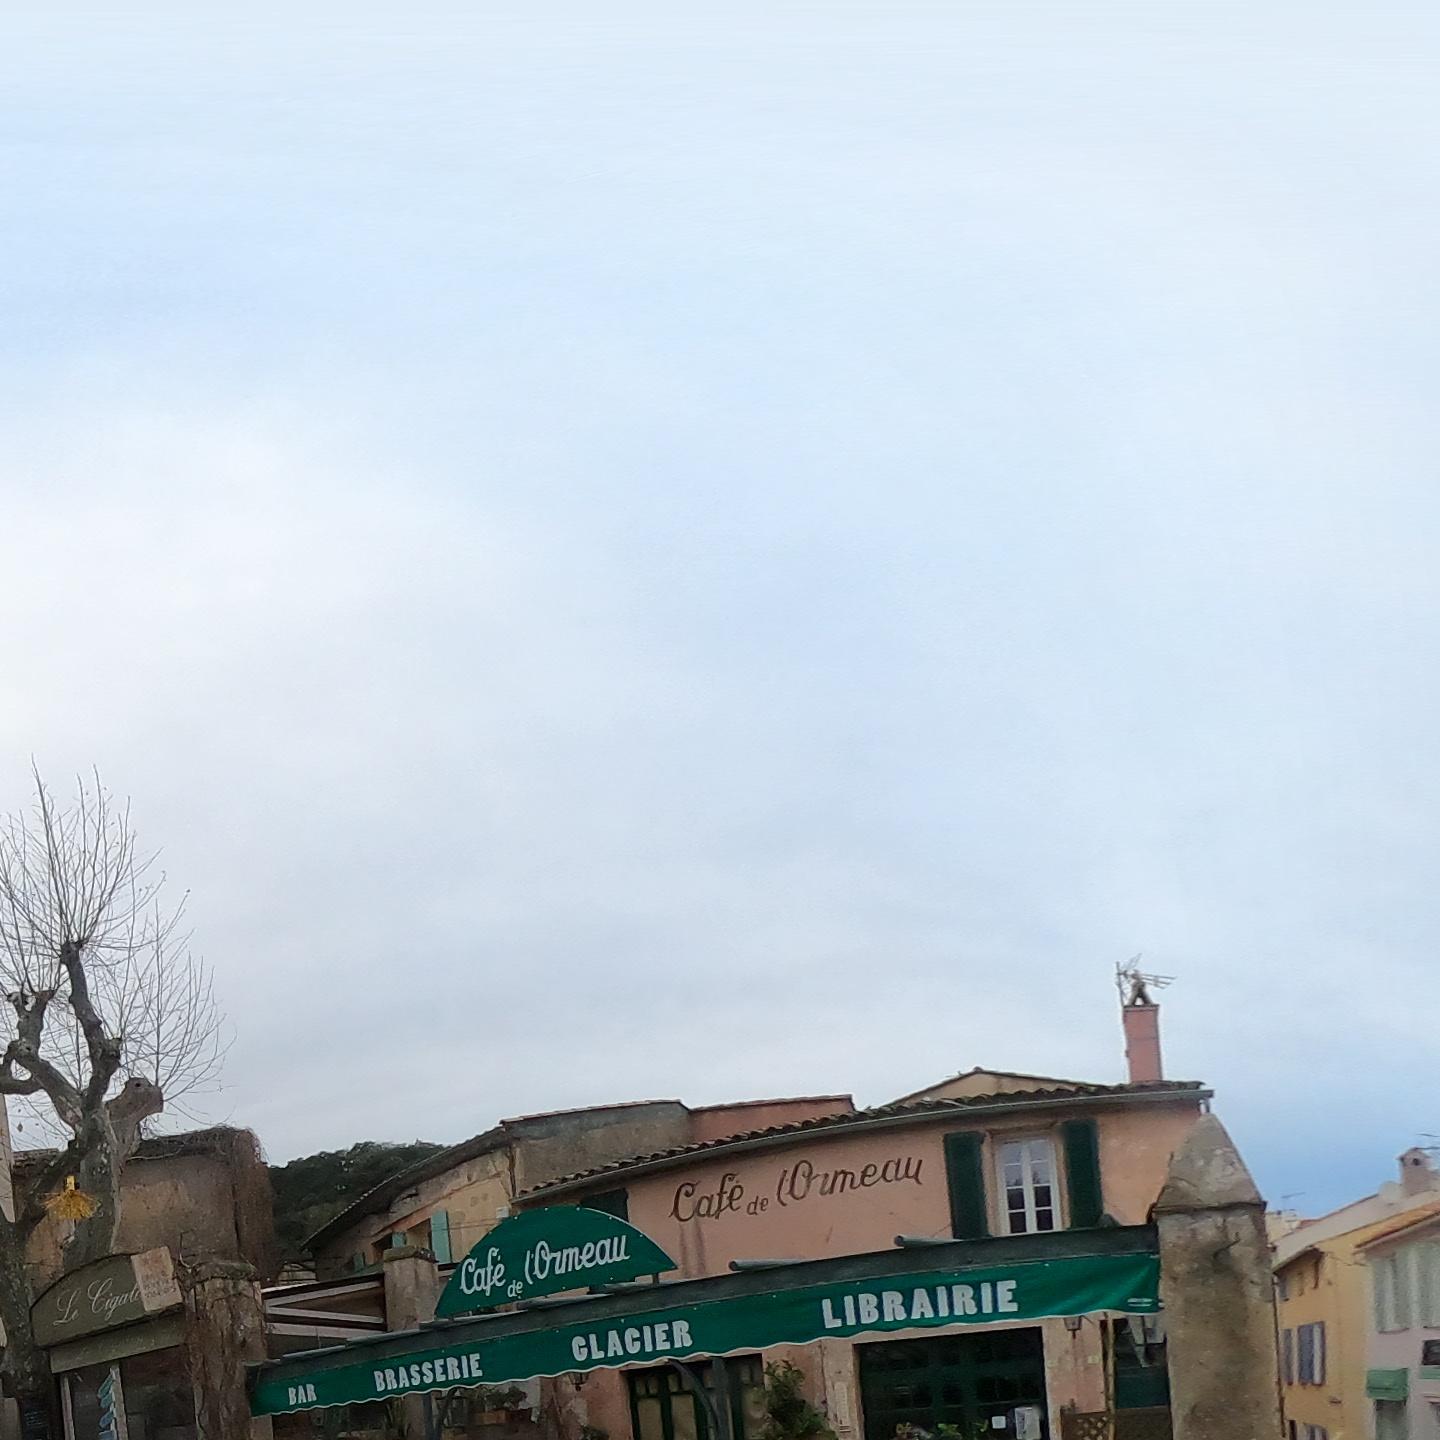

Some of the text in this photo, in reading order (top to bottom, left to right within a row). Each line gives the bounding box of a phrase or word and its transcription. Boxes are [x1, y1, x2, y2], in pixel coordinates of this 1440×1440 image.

[669, 1155, 923, 1222] Café de l'Ormeau
[460, 1235, 630, 1298] Café de l'Ormeau
[53, 1288, 80, 1326] Le
[821, 1279, 1019, 1330] LIBRAIRIE
[571, 1320, 693, 1362] GLACIER
[374, 1353, 483, 1392] BRASSERIE
[288, 1383, 317, 1405] BAR
